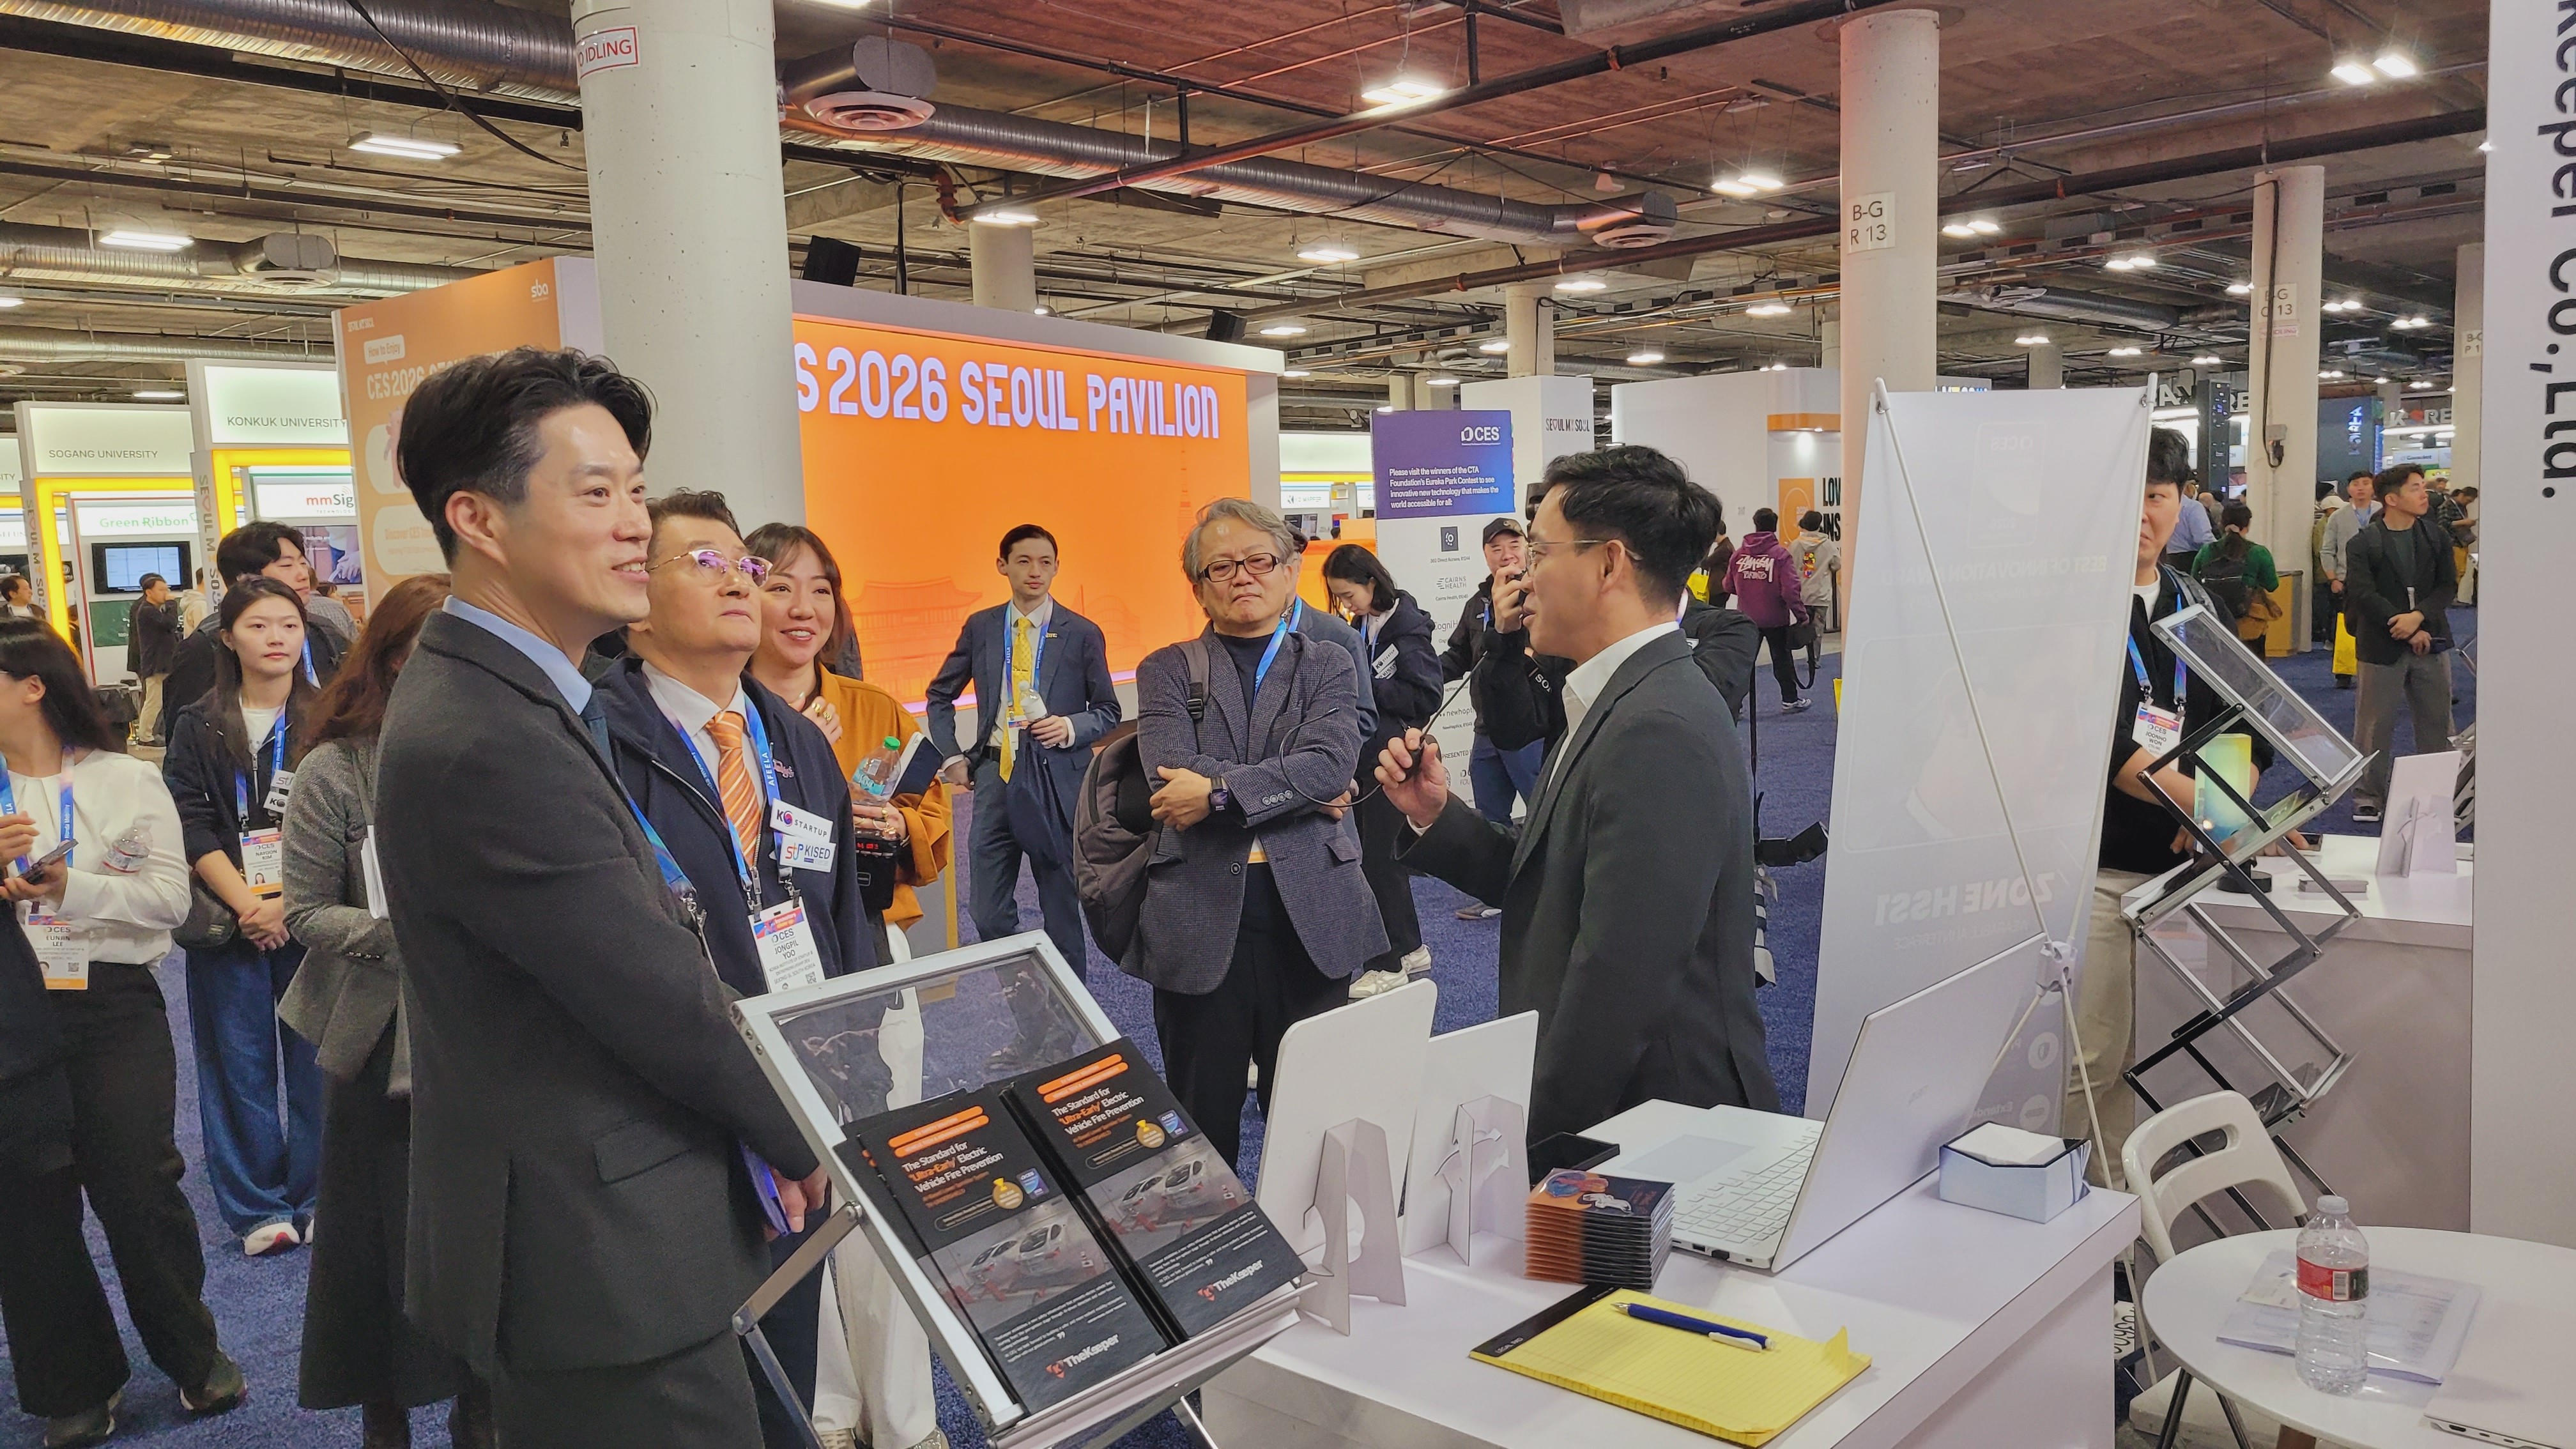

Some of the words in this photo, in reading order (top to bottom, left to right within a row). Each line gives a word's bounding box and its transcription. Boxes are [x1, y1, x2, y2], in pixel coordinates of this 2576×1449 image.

[586, 39, 632, 63] IDLING
[1853, 201, 1883, 221] B-G
[1851, 229, 1859, 245] R
[1866, 224, 1887, 241] 13
[2278, 303, 2292, 315] 13
[368, 345, 379, 358] How
[379, 344, 386, 355] to
[386, 341, 401, 356] Enjoy
[2465, 346, 2471, 354] P
[367, 372, 390, 399] CES
[391, 365, 425, 396] 2026
[795, 342, 819, 412] S
[827, 347, 948, 422] 2026
[960, 361, 1078, 431] SEOUL
[1088, 374, 1219, 439] PAVILION
[227, 417, 277, 427] KONKUK
[280, 418, 346, 427] UNIVERSITY
[1475, 426, 1500, 441] CES
[49, 450, 95, 458] SOGANG
[98, 450, 158, 458] UNIVERSITY
[1389, 468, 1407, 477] Please
[306, 494, 354, 507] mmSig
[1390, 489, 1418, 498] innovative
[1431, 489, 1461, 497] technology
[1407, 499, 1436, 507] accessible
[100, 518, 139, 528] Green
[142, 516, 188, 528] Ribbon
[2154, 724, 2166, 735] CES
[2149, 738, 2163, 746] WON
[1441, 750, 1469, 758] PRESENTED
[762, 752, 775, 786] AFEELA
[795, 819, 827, 837] STARTUP
[805, 845, 831, 859] KISED
[779, 928, 794, 940] CES
[774, 940, 799, 954] JONGPIL
[783, 949, 795, 960] YOO
[1052, 1105, 1068, 1117] The
[1066, 1091, 1100, 1111] Standard
[1098, 1087, 1110, 1100] for
[1101, 1091, 1129, 1108] Electric
[1064, 1118, 1093, 1136] Vehicle
[1092, 1112, 1107, 1125] Fire
[1106, 1096, 1145, 1118] Prevention
[902, 1160, 921, 1173] The
[919, 1147, 956, 1165] Standard
[955, 1141, 968, 1154] for
[956, 1146, 988, 1165] Electric
[914, 1175, 946, 1193] Vehicle
[945, 1169, 962, 1182] Fire
[961, 1153, 1004, 1176] Prevention
[1213, 1259, 1263, 1292] TheKeeper
[1063, 1334, 1119, 1367] TheKeeper
